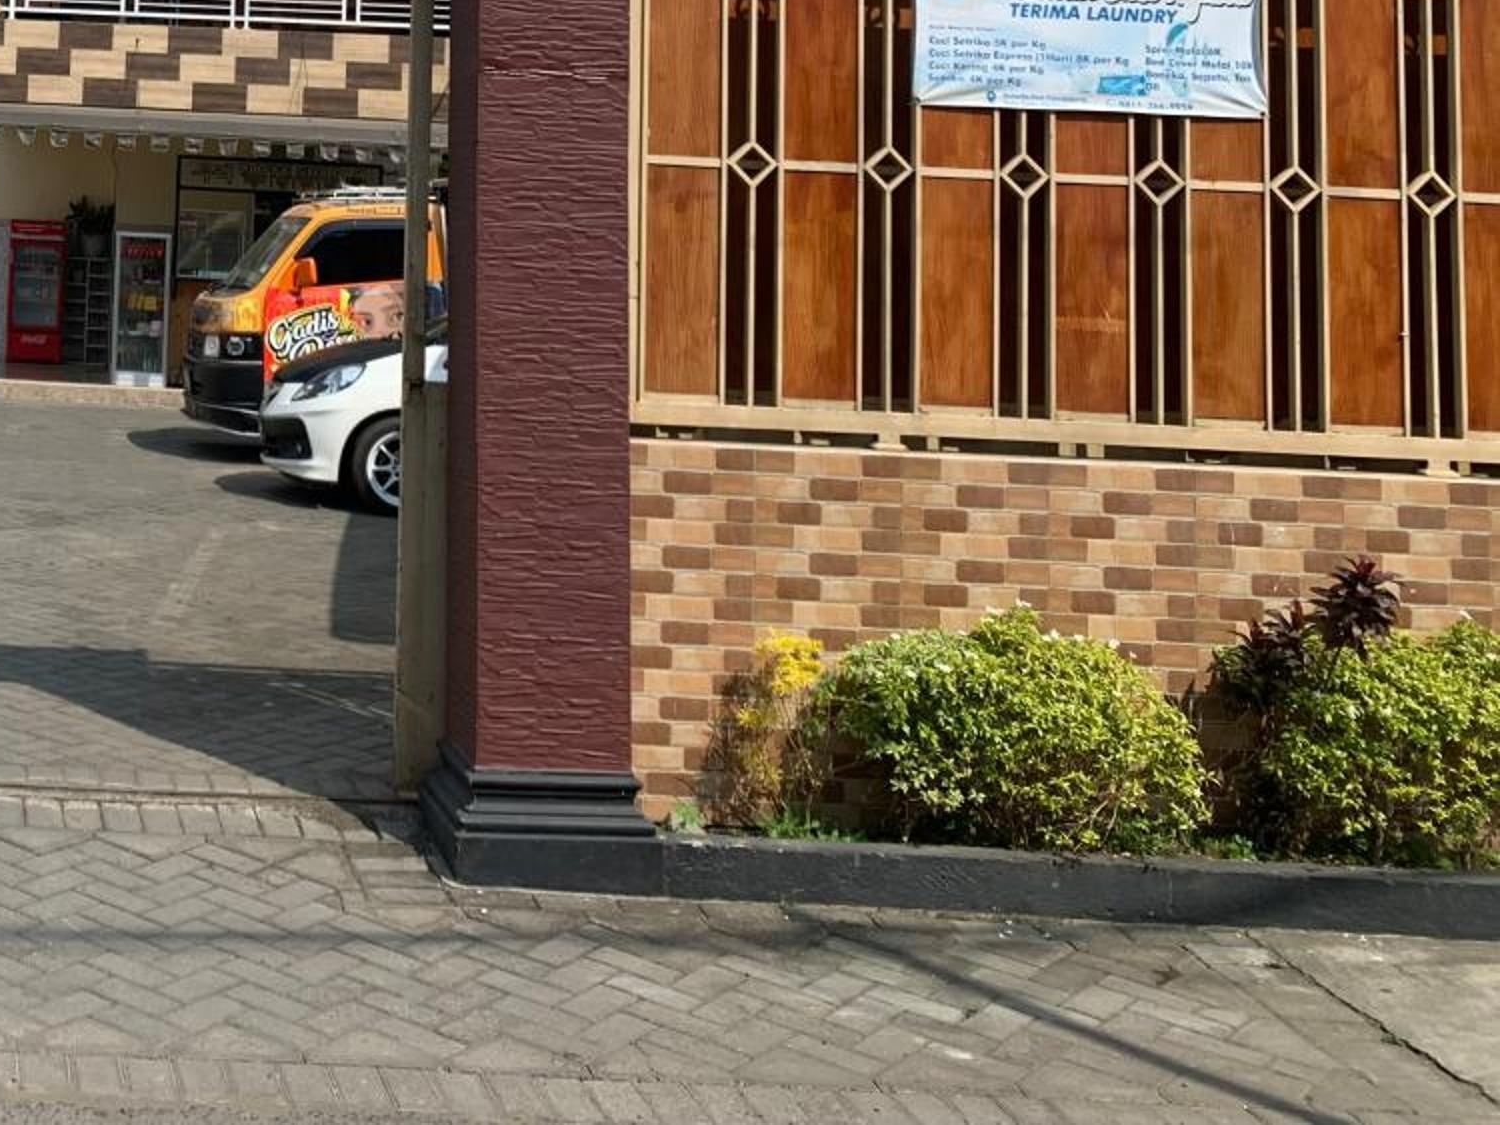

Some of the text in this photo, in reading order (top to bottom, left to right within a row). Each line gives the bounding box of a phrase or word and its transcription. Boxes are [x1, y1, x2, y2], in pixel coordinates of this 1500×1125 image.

[1010, 2, 1178, 24] TERIMA LAUNDRY
[269, 309, 338, 359] Gadis
